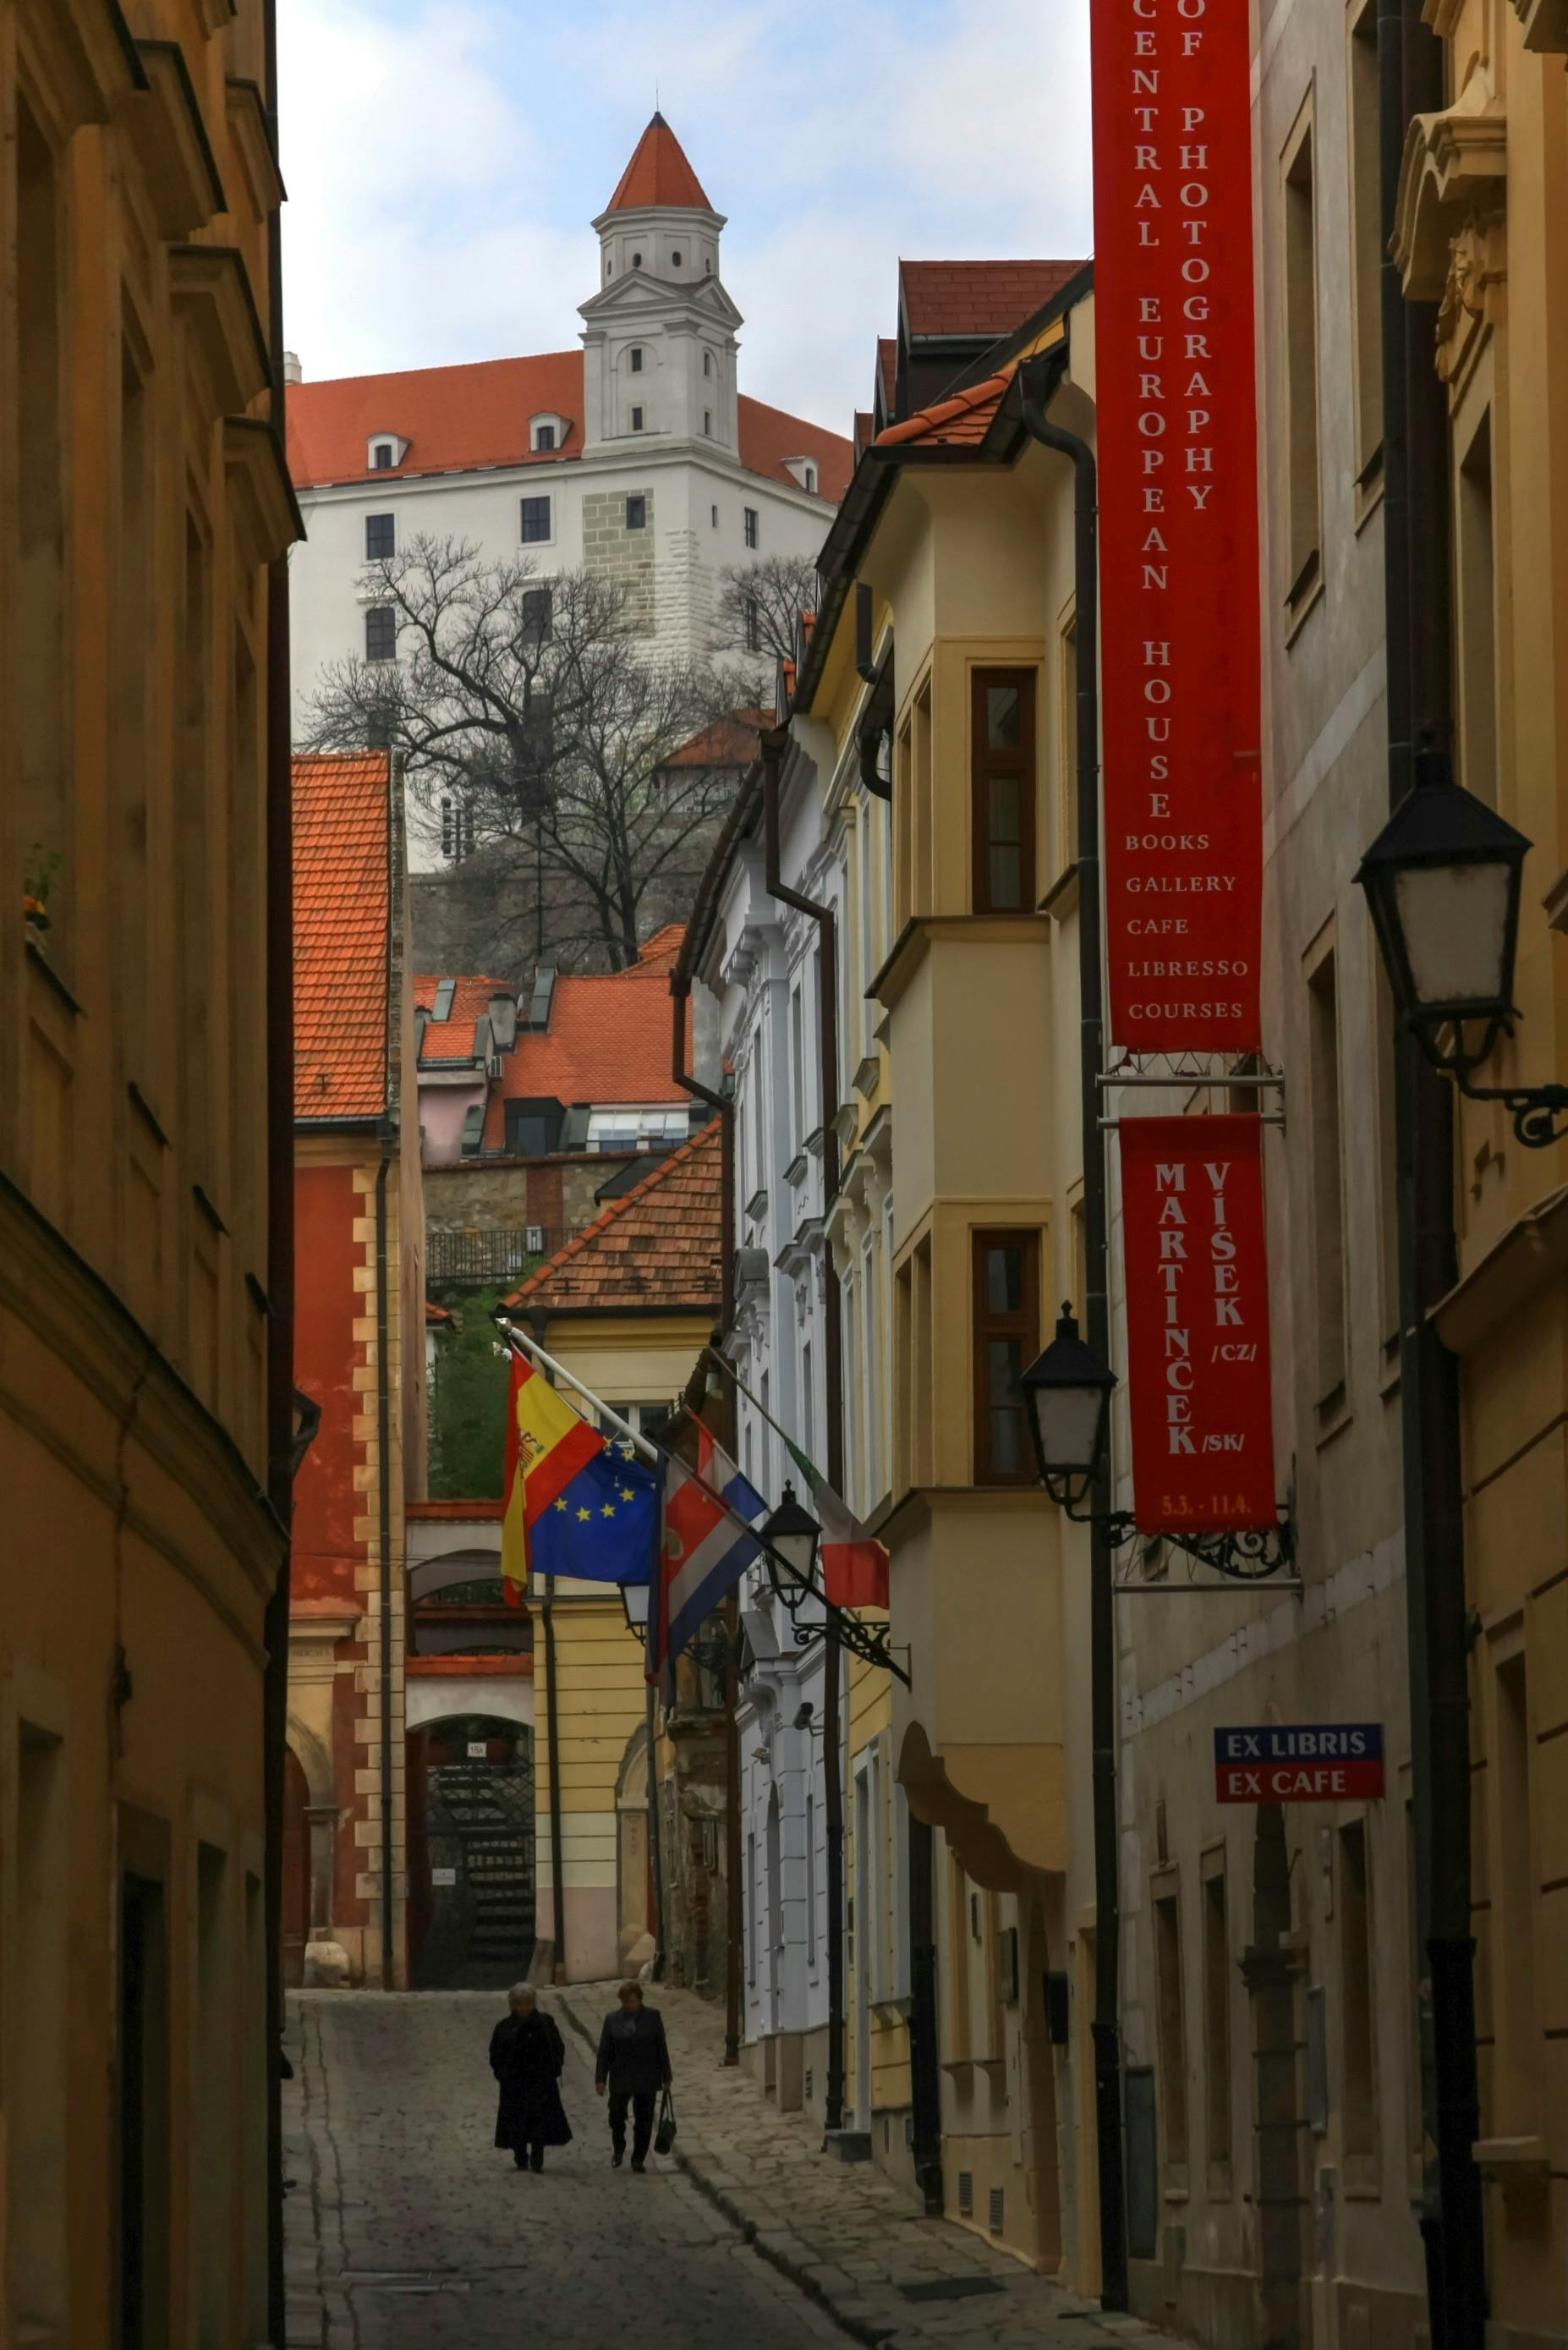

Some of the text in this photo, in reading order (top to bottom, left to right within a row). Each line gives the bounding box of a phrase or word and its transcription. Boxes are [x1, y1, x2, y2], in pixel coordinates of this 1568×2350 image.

[1176, 0, 1214, 510] OF PHOTOGRAPHY
[1132, 0, 1171, 818] CENTRAL EUROPEAN HOUSE
[1125, 834, 1209, 850] BOOKS
[1126, 876, 1236, 892] GALLERY
[1127, 919, 1188, 935] CAFE
[1128, 960, 1248, 977] LIBRESSO
[1128, 1002, 1242, 1019] COURSES
[1203, 1162, 1258, 1364] VÍŠEK /CZ/
[1154, 1163, 1245, 1454] MARTINČEK /SK/
[1227, 1731, 1366, 1757] EX LIBRIS
[1228, 1770, 1346, 1795] EX CAFE
